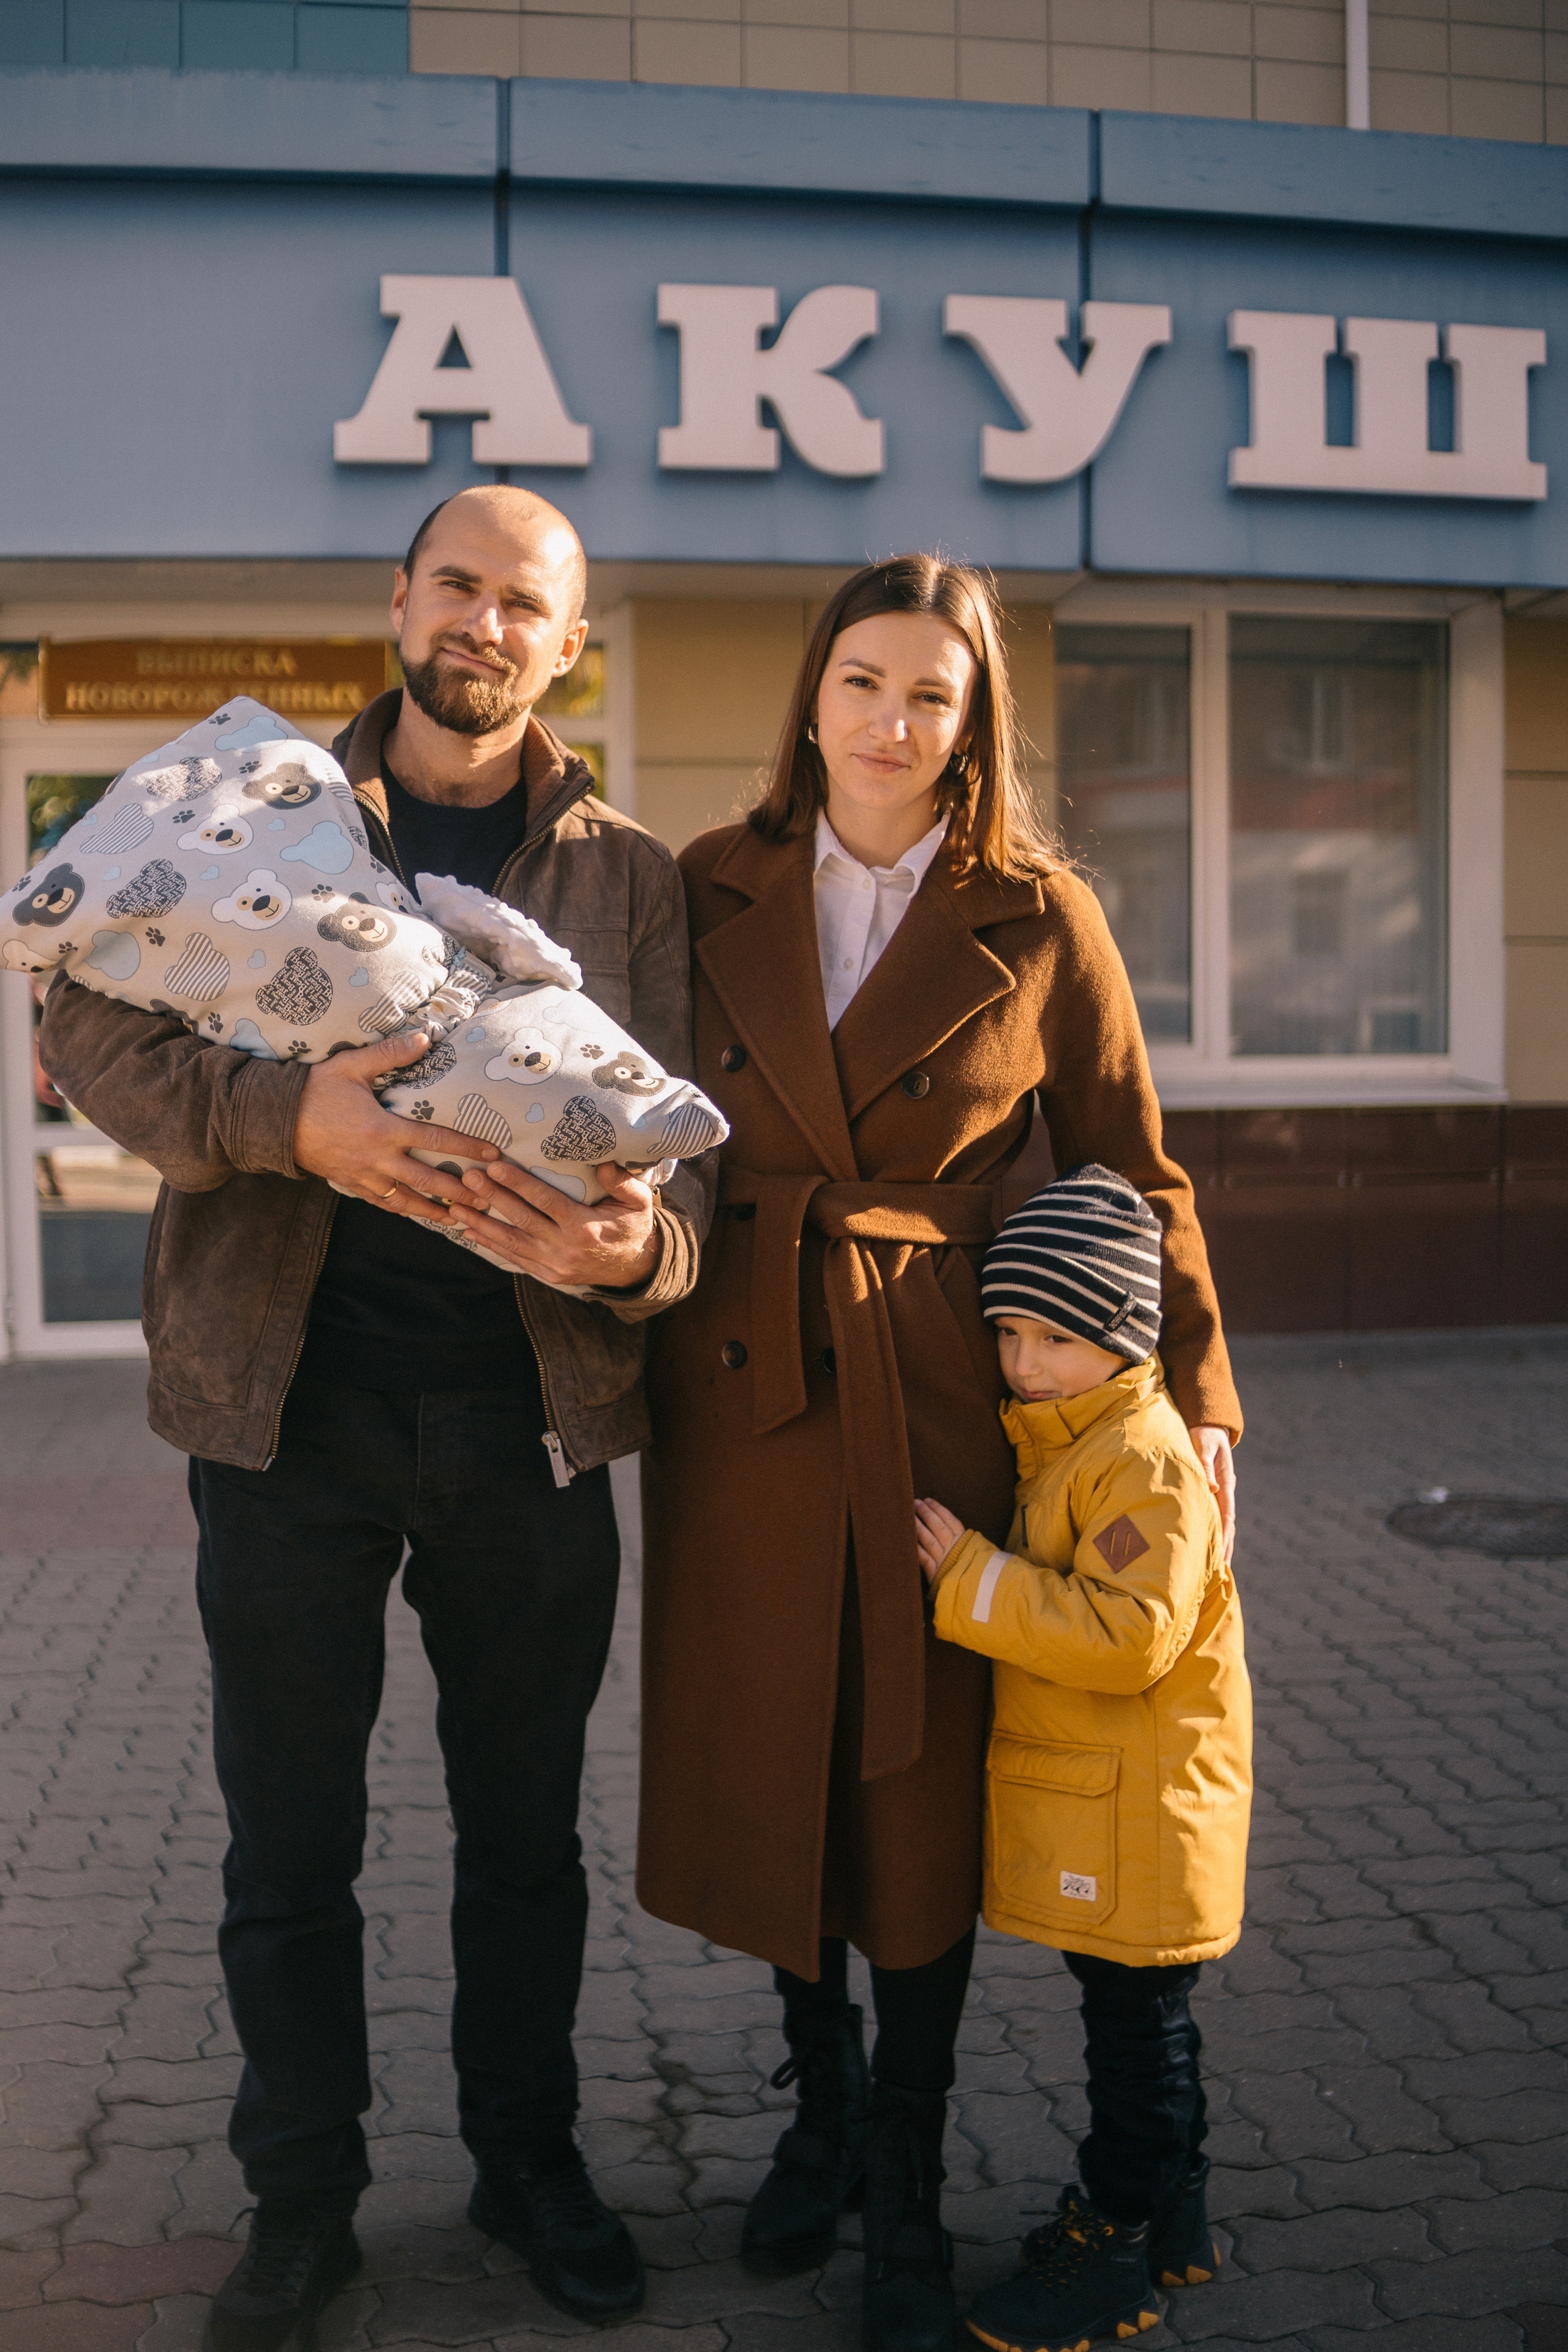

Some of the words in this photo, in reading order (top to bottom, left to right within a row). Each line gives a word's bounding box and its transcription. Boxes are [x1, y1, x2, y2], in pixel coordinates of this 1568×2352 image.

[333, 273, 1547, 501] АКУШ
[136, 646, 296, 676] ВЫПИСКА
[143, 880, 161, 890] Bear
[167, 873, 184, 884] Bear
[124, 883, 141, 895] Bear
[108, 895, 123, 906] Bear
[134, 900, 152, 914] Bear
[290, 954, 309, 971] Bear
[302, 955, 317, 969] Bear
[291, 964, 306, 978] Bear
[271, 977, 288, 994] Bear
[281, 977, 296, 992] Bear
[290, 975, 308, 992] Bear
[307, 977, 322, 992] Bear
[312, 970, 331, 988] Bear
[257, 989, 272, 1003] Bear
[276, 990, 289, 1004] Bear
[295, 992, 313, 1008] Bear
[307, 995, 323, 1008] Bear
[276, 1005, 290, 1019] Bear
[284, 1003, 301, 1019] Bear
[293, 1006, 311, 1023] Bear
[425, 1066, 442, 1075] Bear
[569, 1103, 589, 1119] Bear
[570, 1113, 586, 1126] Bear
[593, 1116, 612, 1132] Bear
[553, 1128, 572, 1142] Bear
[562, 1128, 578, 1139] Bear
[571, 1124, 590, 1138] Bear
[589, 1123, 605, 1136] Bear
[542, 1140, 557, 1152] Bear
